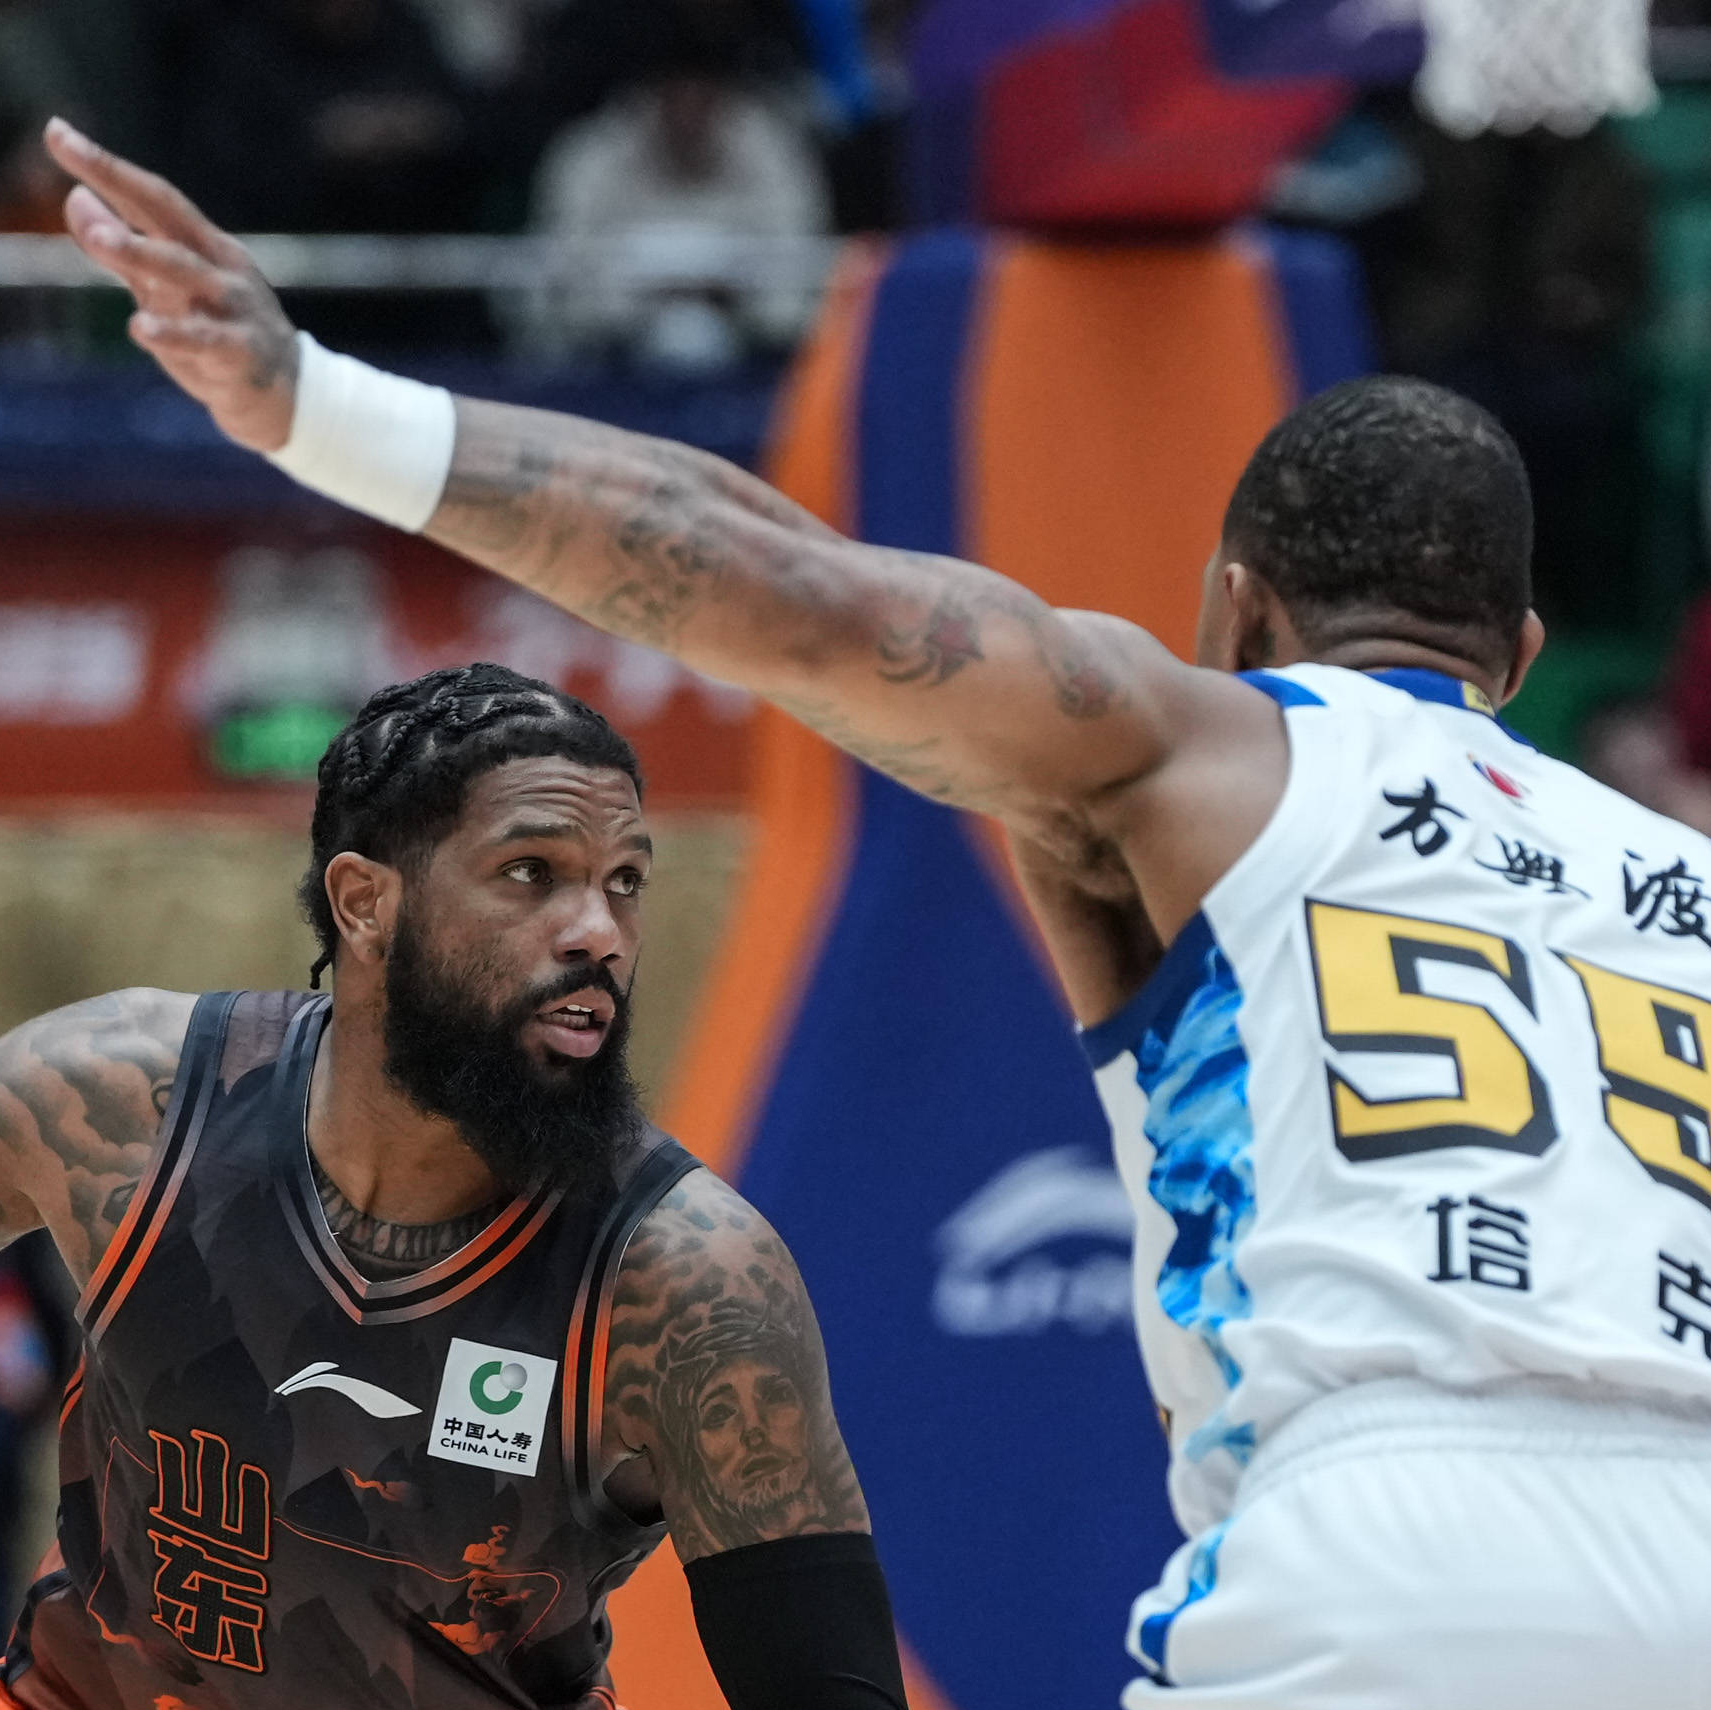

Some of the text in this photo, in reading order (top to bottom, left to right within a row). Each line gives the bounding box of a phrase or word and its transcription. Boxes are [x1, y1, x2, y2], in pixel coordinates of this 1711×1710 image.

[440, 1437, 528, 1463] CHINA LIFE
[443, 1417, 533, 1450] 中国人寿
[147, 1428, 270, 1673] 山东
